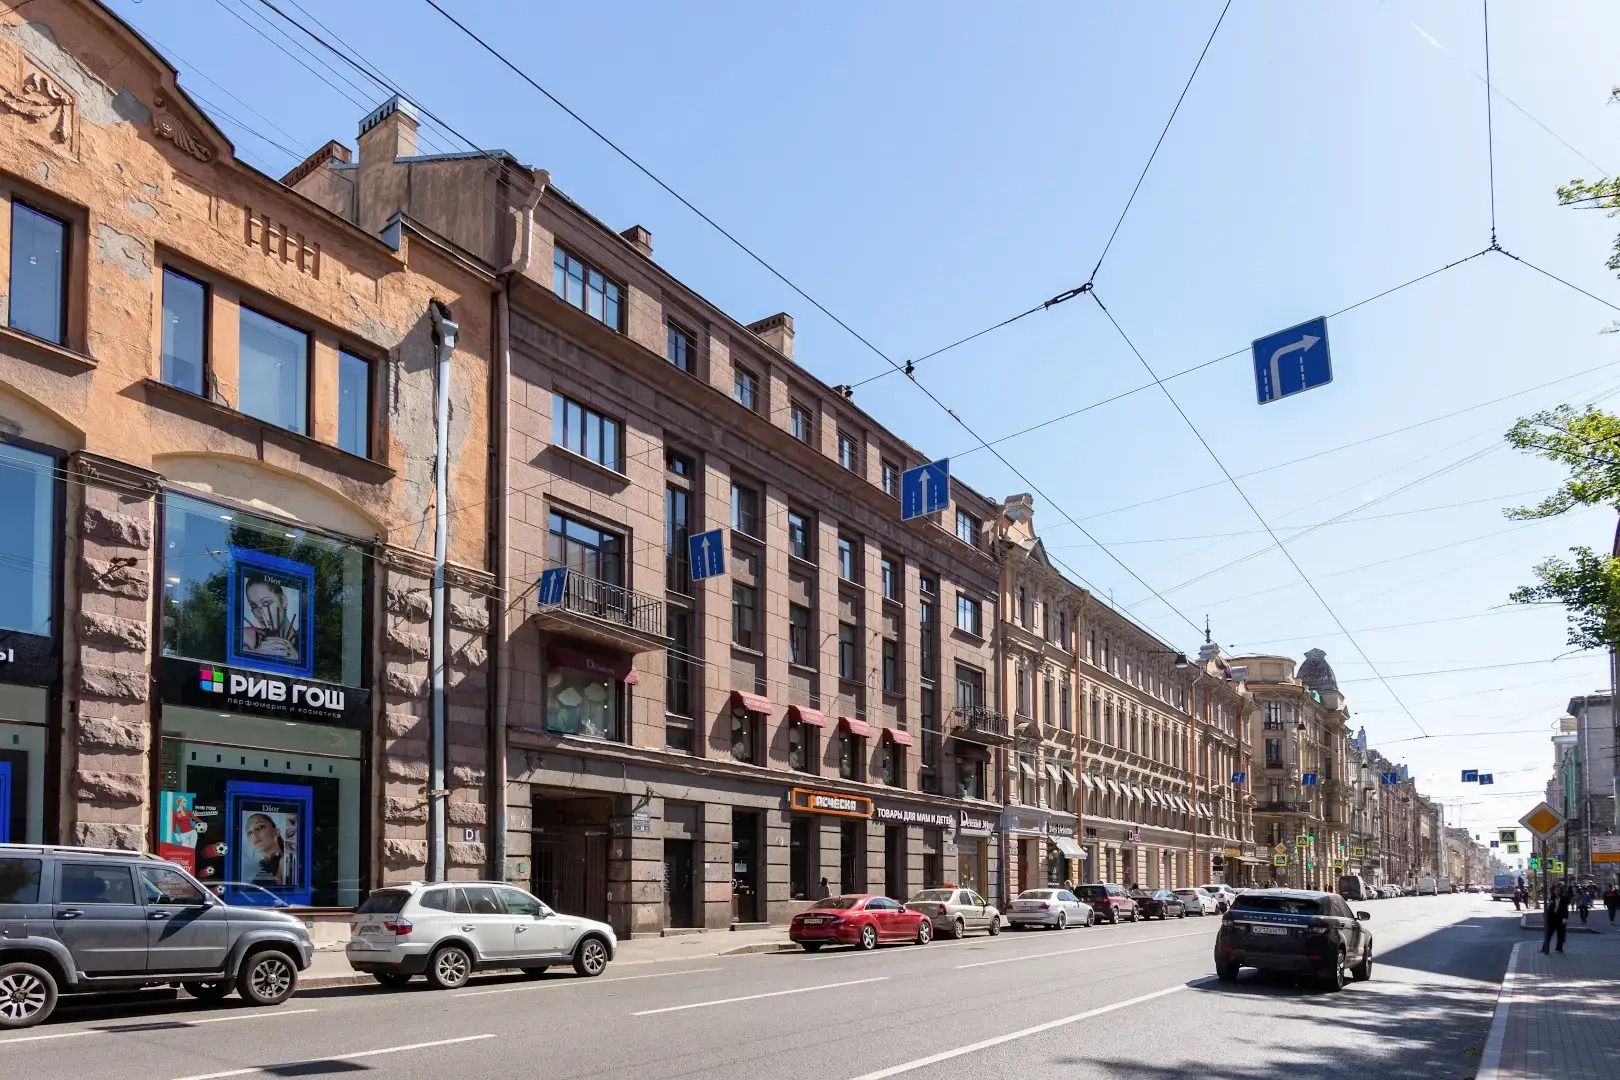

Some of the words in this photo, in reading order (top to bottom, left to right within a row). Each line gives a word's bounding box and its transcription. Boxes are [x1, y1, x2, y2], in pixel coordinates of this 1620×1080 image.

[264, 575, 282, 585] Dior
[230, 674, 287, 702] РИВ
[292, 684, 345, 710] ГОШ
[227, 697, 287, 711] парфюмерия
[298, 707, 342, 719] косметика
[877, 808, 903, 819] ТОВАРЫ
[903, 811, 916, 822] ДЛЯ
[916, 812, 931, 823] МАМ
[931, 814, 936, 824] И
[935, 814, 953, 825] ДЕТЕЙ
